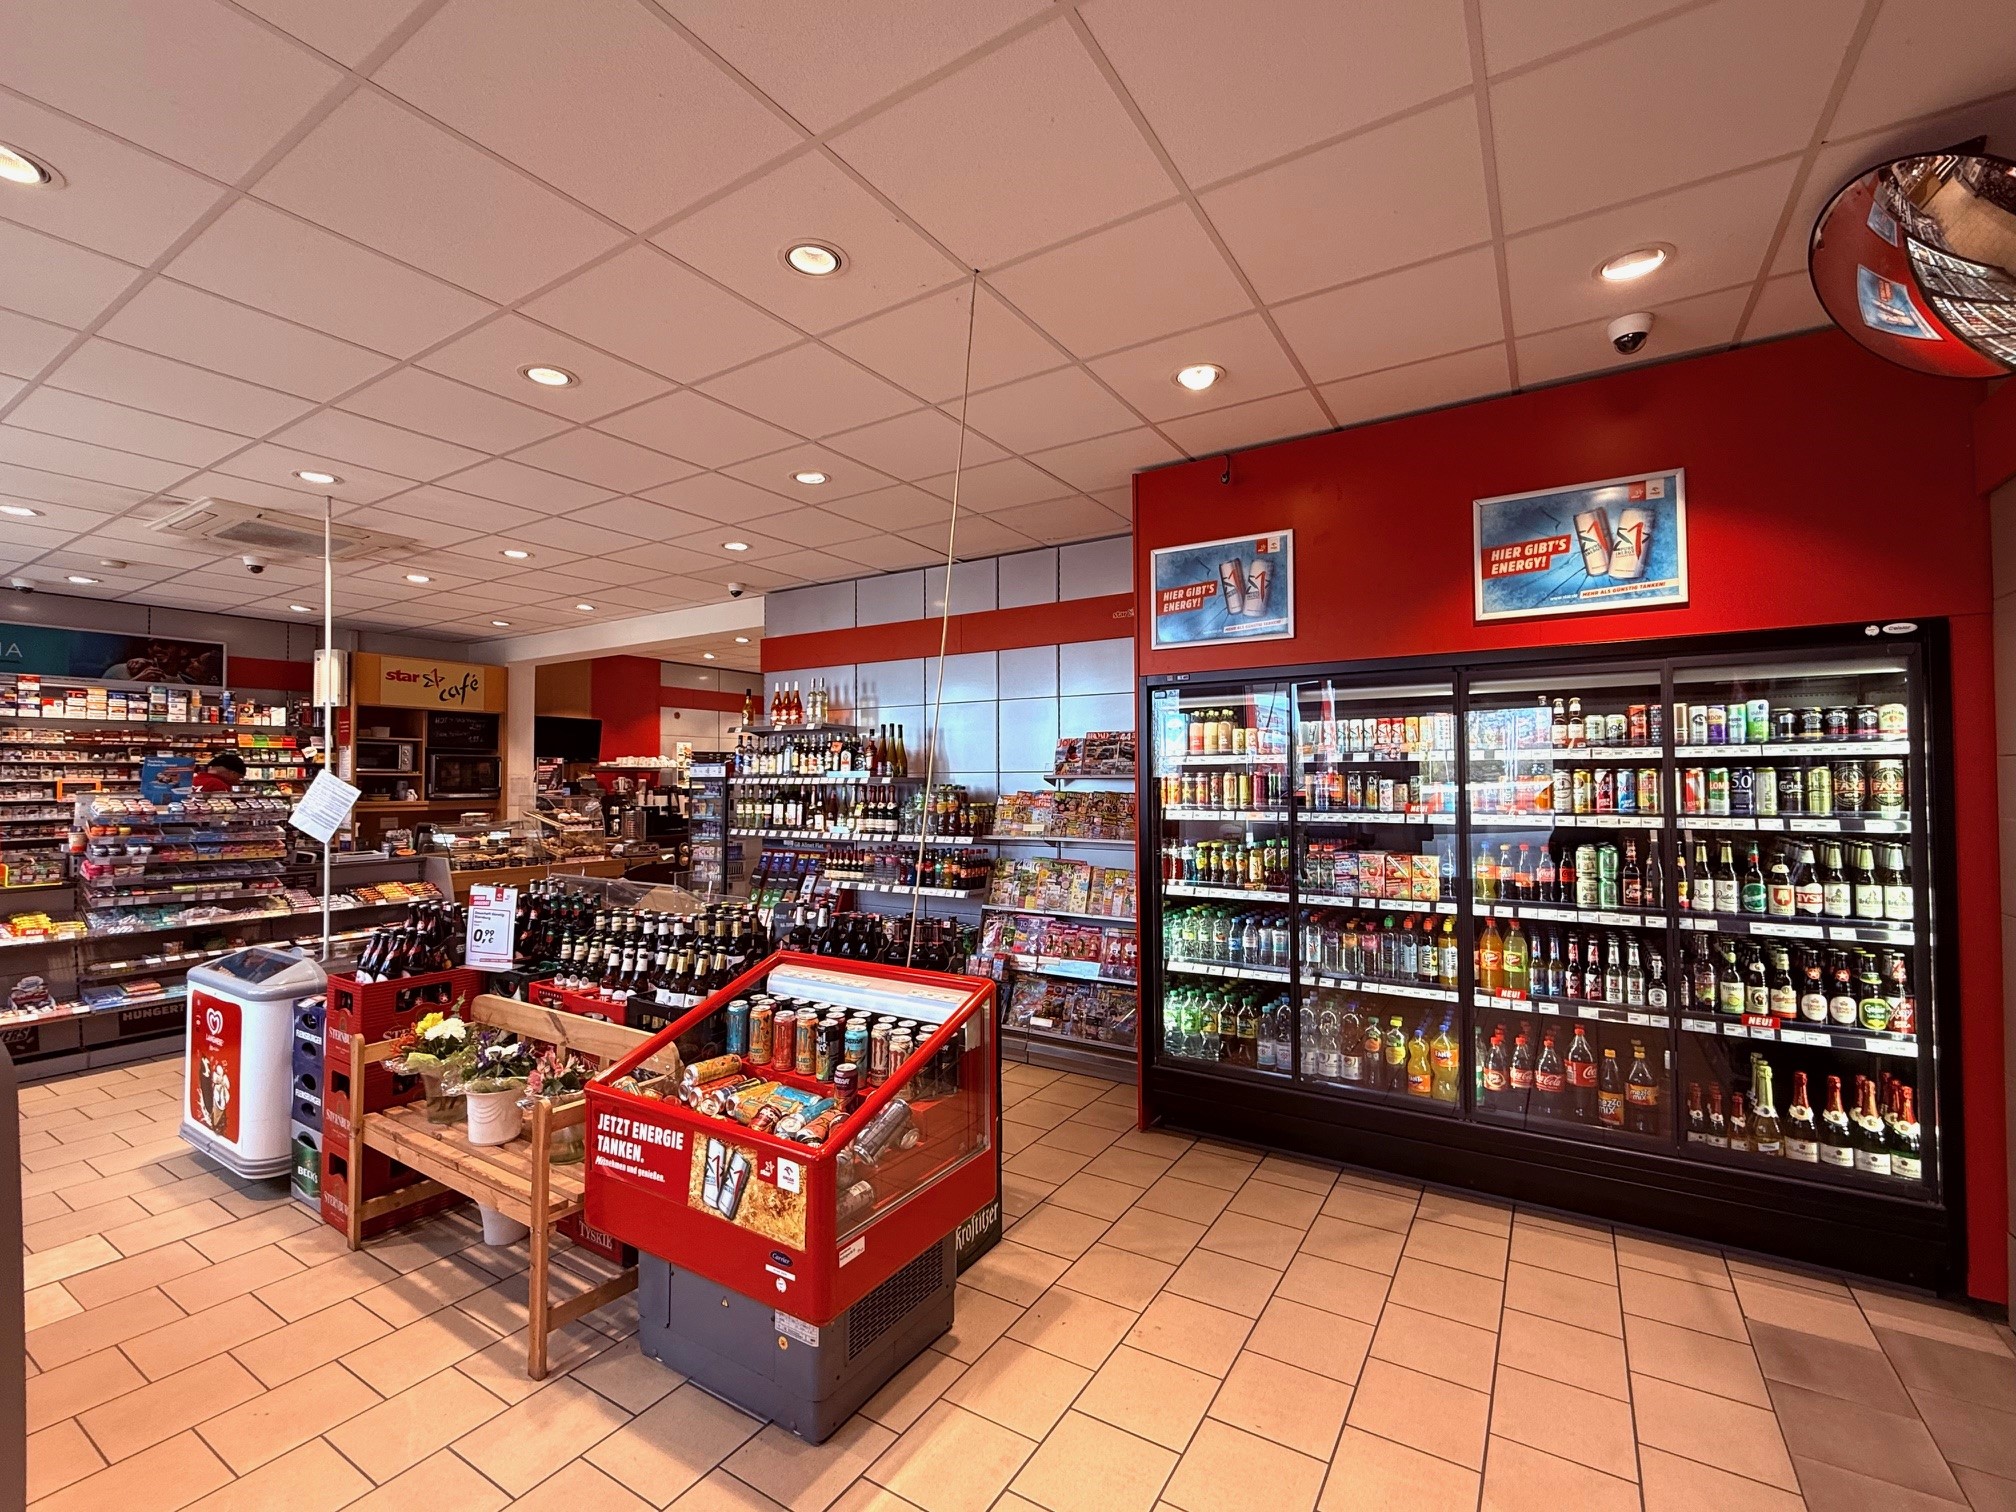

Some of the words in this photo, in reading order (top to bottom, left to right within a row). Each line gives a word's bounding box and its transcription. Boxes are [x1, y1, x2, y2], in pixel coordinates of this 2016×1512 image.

[1491, 546, 1521, 561] HIER
[1523, 538, 1567, 555] GIBT'S
[1491, 557, 1546, 575] ENERGY!
[1163, 589, 1184, 601] HIER
[1186, 583, 1215, 598] GIBT'S
[1612, 584, 1638, 593] GÜNSTIG
[1639, 581, 1666, 589] TANKEN!
[1163, 598, 1201, 613] ENERGY!
[385, 669, 420, 683] star
[439, 672, 479, 705] café
[1731, 774, 1752, 789] 5.0
[1835, 781, 1865, 791] FAXE
[1875, 781, 1904, 791] FAXE
[1410, 804, 1429, 813] NEU!
[1501, 989, 1521, 999] NEU!
[122, 1003, 185, 1021] HUNGER?
[1748, 1016, 1773, 1027] NEU!
[597, 1113, 631, 1137] JETZT
[631, 1120, 684, 1151] ENERGIE
[597, 1134, 645, 1164] TANKEN.
[595, 1155, 627, 1172] Mitnehmen
[626, 1165, 638, 1175] und
[637, 1168, 666, 1183] genießen.
[579, 1219, 613, 1250] TYSKIE
[771, 1252, 790, 1265] Carrier
